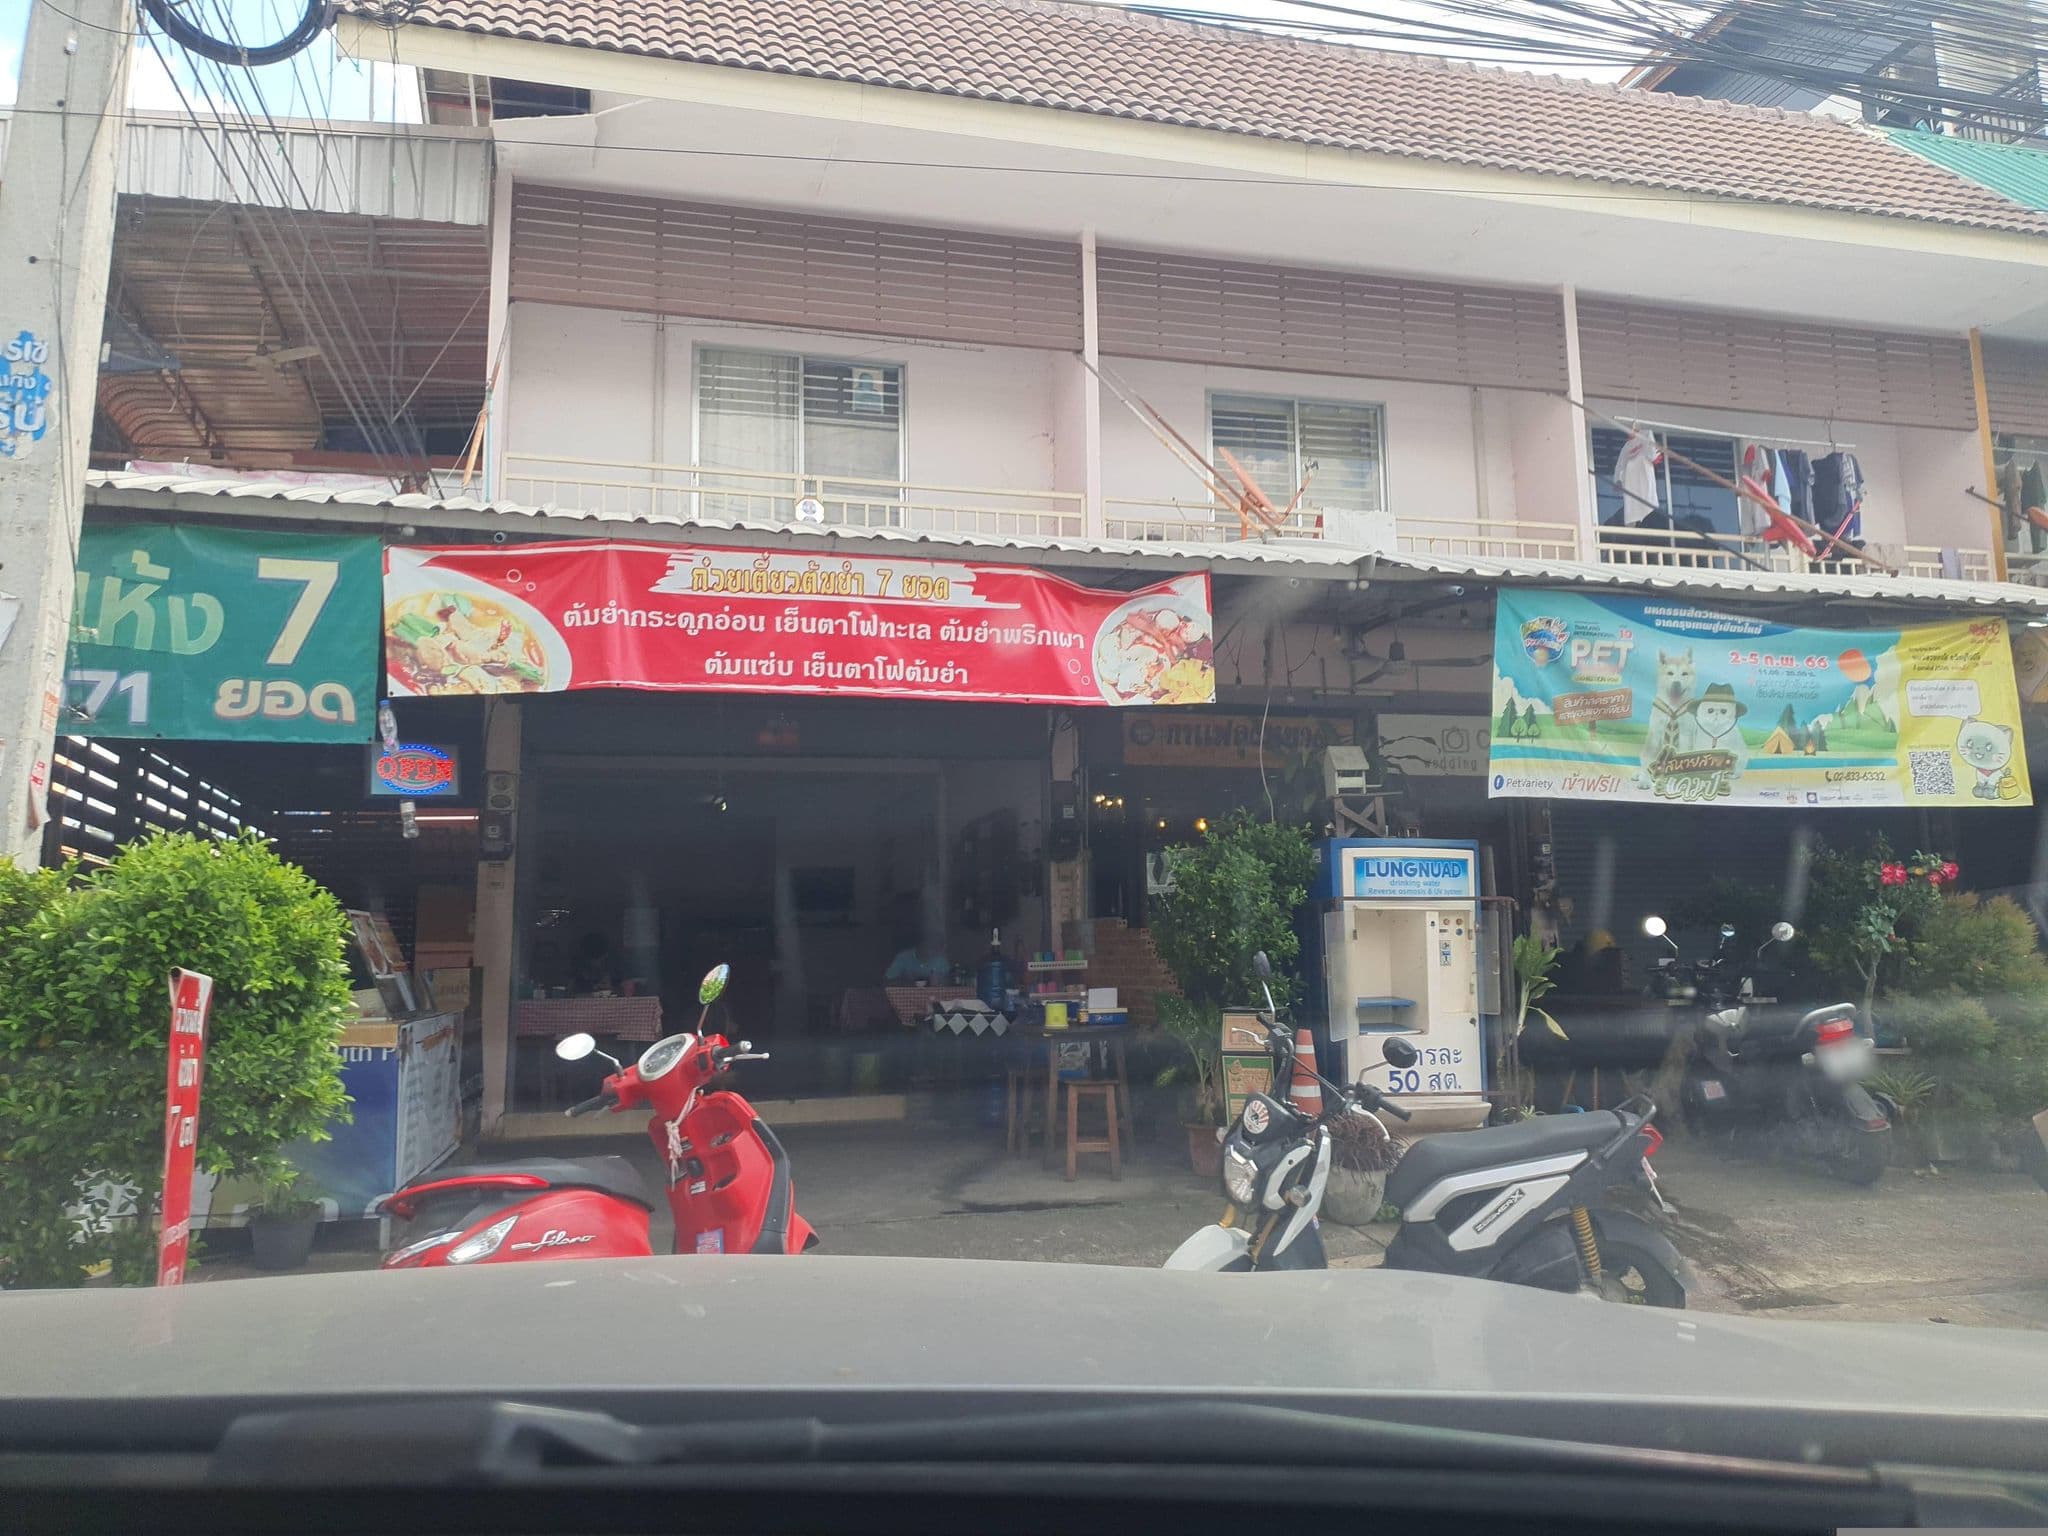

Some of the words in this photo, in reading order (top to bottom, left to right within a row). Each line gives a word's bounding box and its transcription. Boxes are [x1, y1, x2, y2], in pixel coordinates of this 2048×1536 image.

[877, 568, 894, 597] 7
[902, 574, 951, 601] ยอด
[257, 557, 340, 667] 7
[563, 600, 764, 637] ต้มยำกระดูกอ่อน
[775, 606, 931, 640] เย็นตาโฟทะเล
[940, 616, 1085, 650] ต้มยำพริกเผา
[705, 651, 793, 677] ต้มแซ่บ
[803, 652, 969, 685] เย็นตาโฟต้มยำ
[1571, 638, 1634, 670] PET
[1804, 656, 1831, 671] 66
[215, 678, 358, 725] ยอด
[376, 756, 456, 781] OPEN
[1365, 860, 1462, 878] LUNGNUAD
[1389, 878, 1421, 888] drinking
[1368, 887, 1397, 895] Reverse
[1388, 1070, 1420, 1093] 50
[1428, 1071, 1462, 1091] สต.
